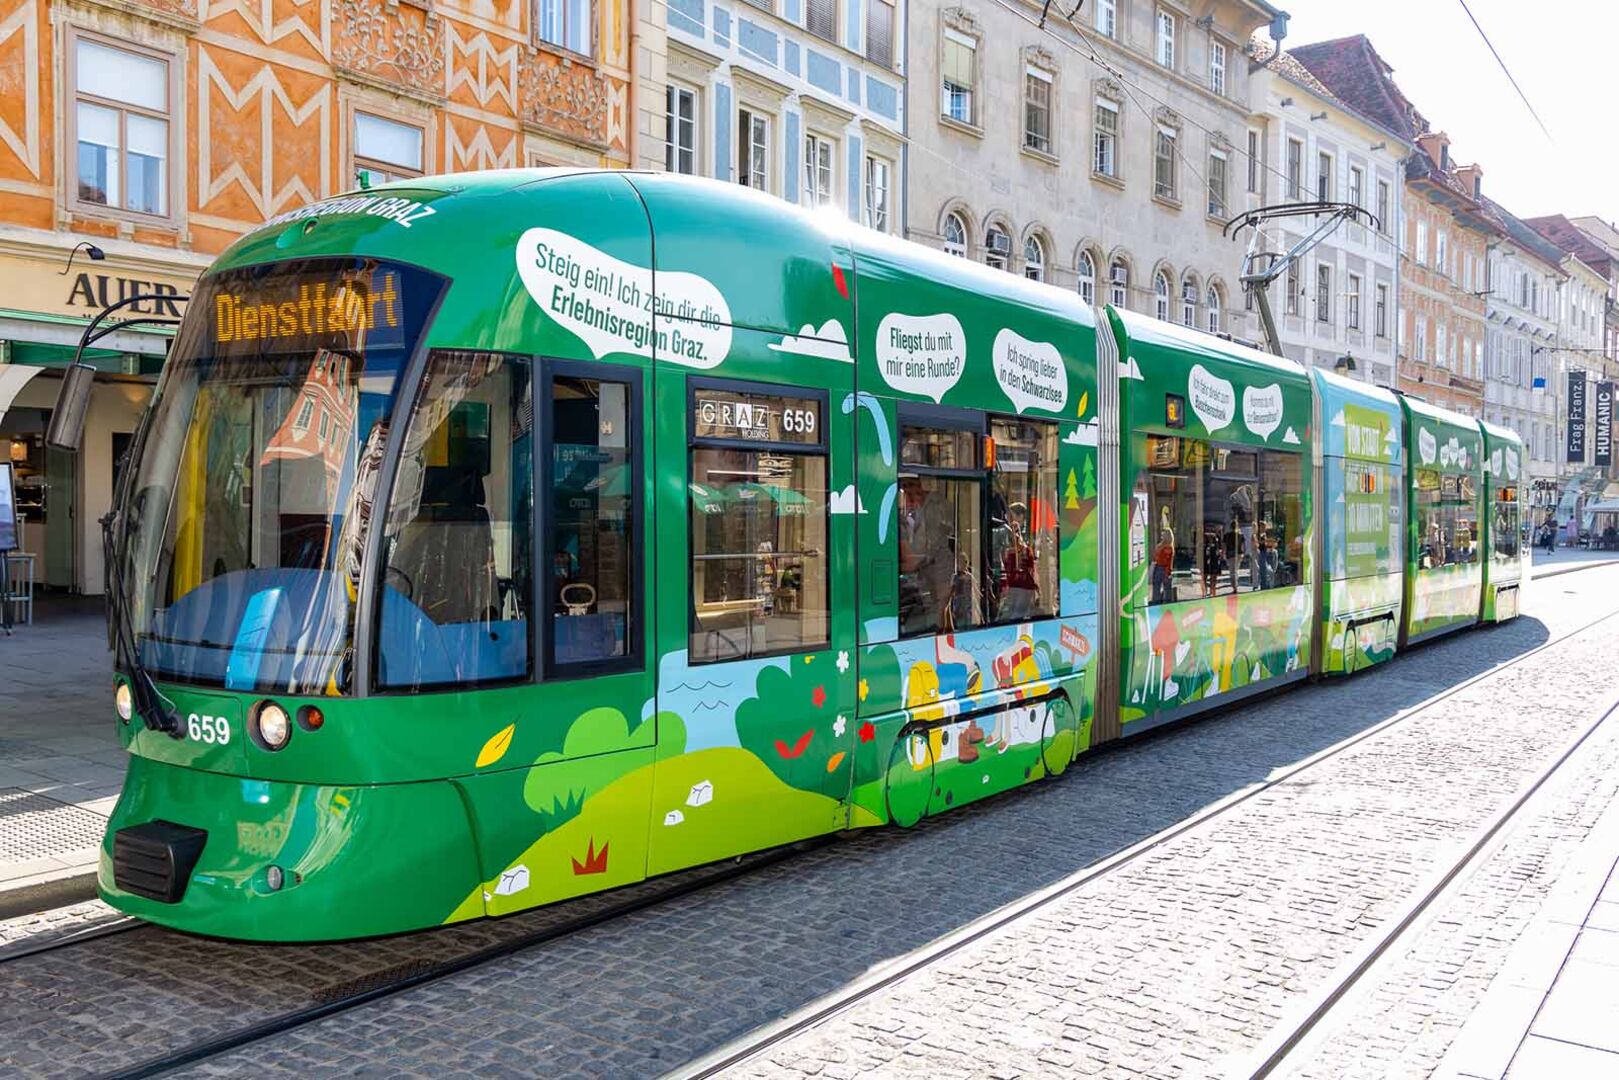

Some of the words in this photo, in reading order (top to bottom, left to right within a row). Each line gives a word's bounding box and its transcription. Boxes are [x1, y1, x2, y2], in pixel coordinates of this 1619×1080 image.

[366, 197, 436, 228] GRAZ
[66, 273, 182, 317] AUER
[536, 242, 580, 288] Steig
[585, 267, 614, 297] ein!
[618, 276, 640, 307] Ich
[645, 292, 673, 324] zeig
[678, 299, 696, 325] dir
[700, 305, 721, 331] die
[215, 275, 397, 342] Dienstfahrt
[551, 284, 668, 350] Erlebnisregion
[672, 329, 708, 361] Graz.
[890, 327, 923, 354] Fliegst
[924, 332, 936, 351] du
[937, 331, 953, 351] mit
[886, 356, 903, 376] mir
[905, 357, 926, 378] eine
[928, 356, 960, 378] Runde?
[1000, 364, 1007, 382] in
[1008, 369, 1020, 389] den
[1007, 343, 1018, 364] Ich
[1018, 353, 1039, 378] spring
[1570, 381, 1583, 420] Franz.
[701, 401, 768, 428] GRAZ
[783, 408, 815, 433] 659
[1597, 392, 1611, 456] HUMANIC
[741, 429, 769, 439] HOLDING
[1570, 423, 1585, 452] Frag
[188, 713, 230, 745] 659
